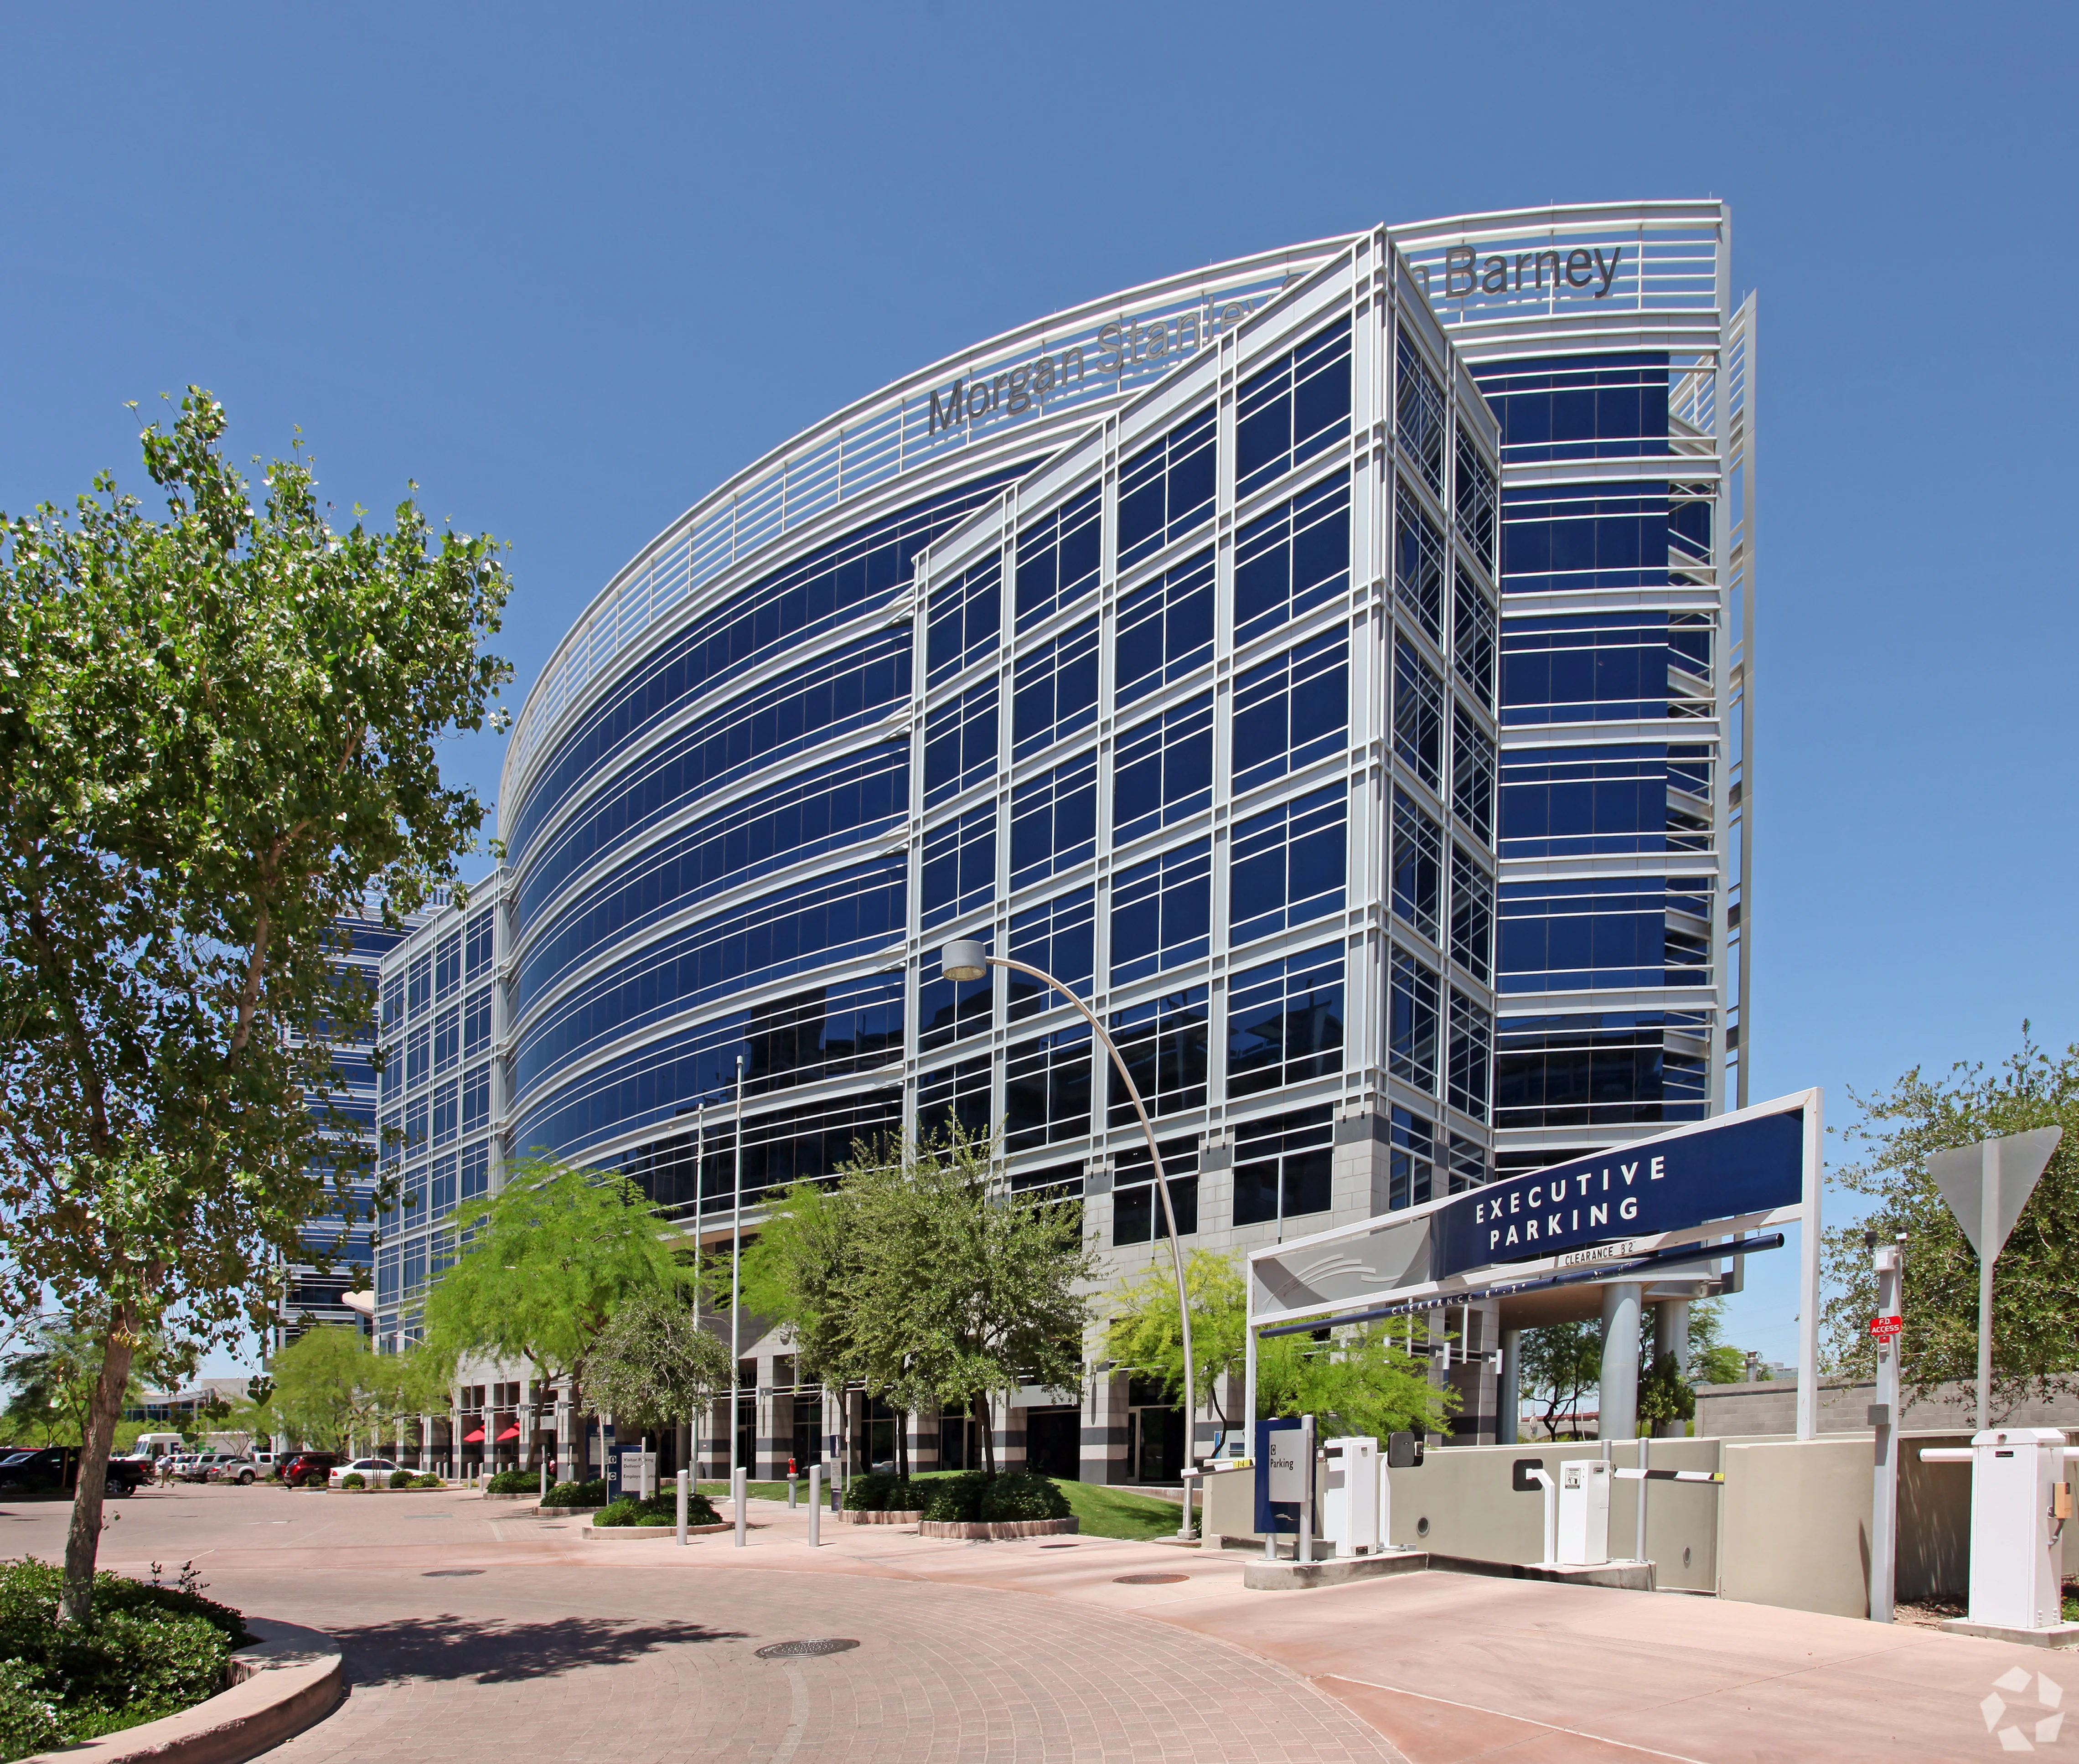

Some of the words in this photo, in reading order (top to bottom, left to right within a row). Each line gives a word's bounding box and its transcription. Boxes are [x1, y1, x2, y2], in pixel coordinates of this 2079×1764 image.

[929, 346, 1084, 436] Morgan
[1446, 245, 1621, 298] Barney
[1476, 1156, 1664, 1224] EXECUTIVE
[1490, 1197, 1637, 1250] PARKING
[1565, 1247, 1613, 1266] CLEARANCE
[1392, 1293, 1473, 1314] CLEARANCE
[1871, 1324, 1899, 1333] ACCESS
[1271, 1458, 1294, 1470] Parking
